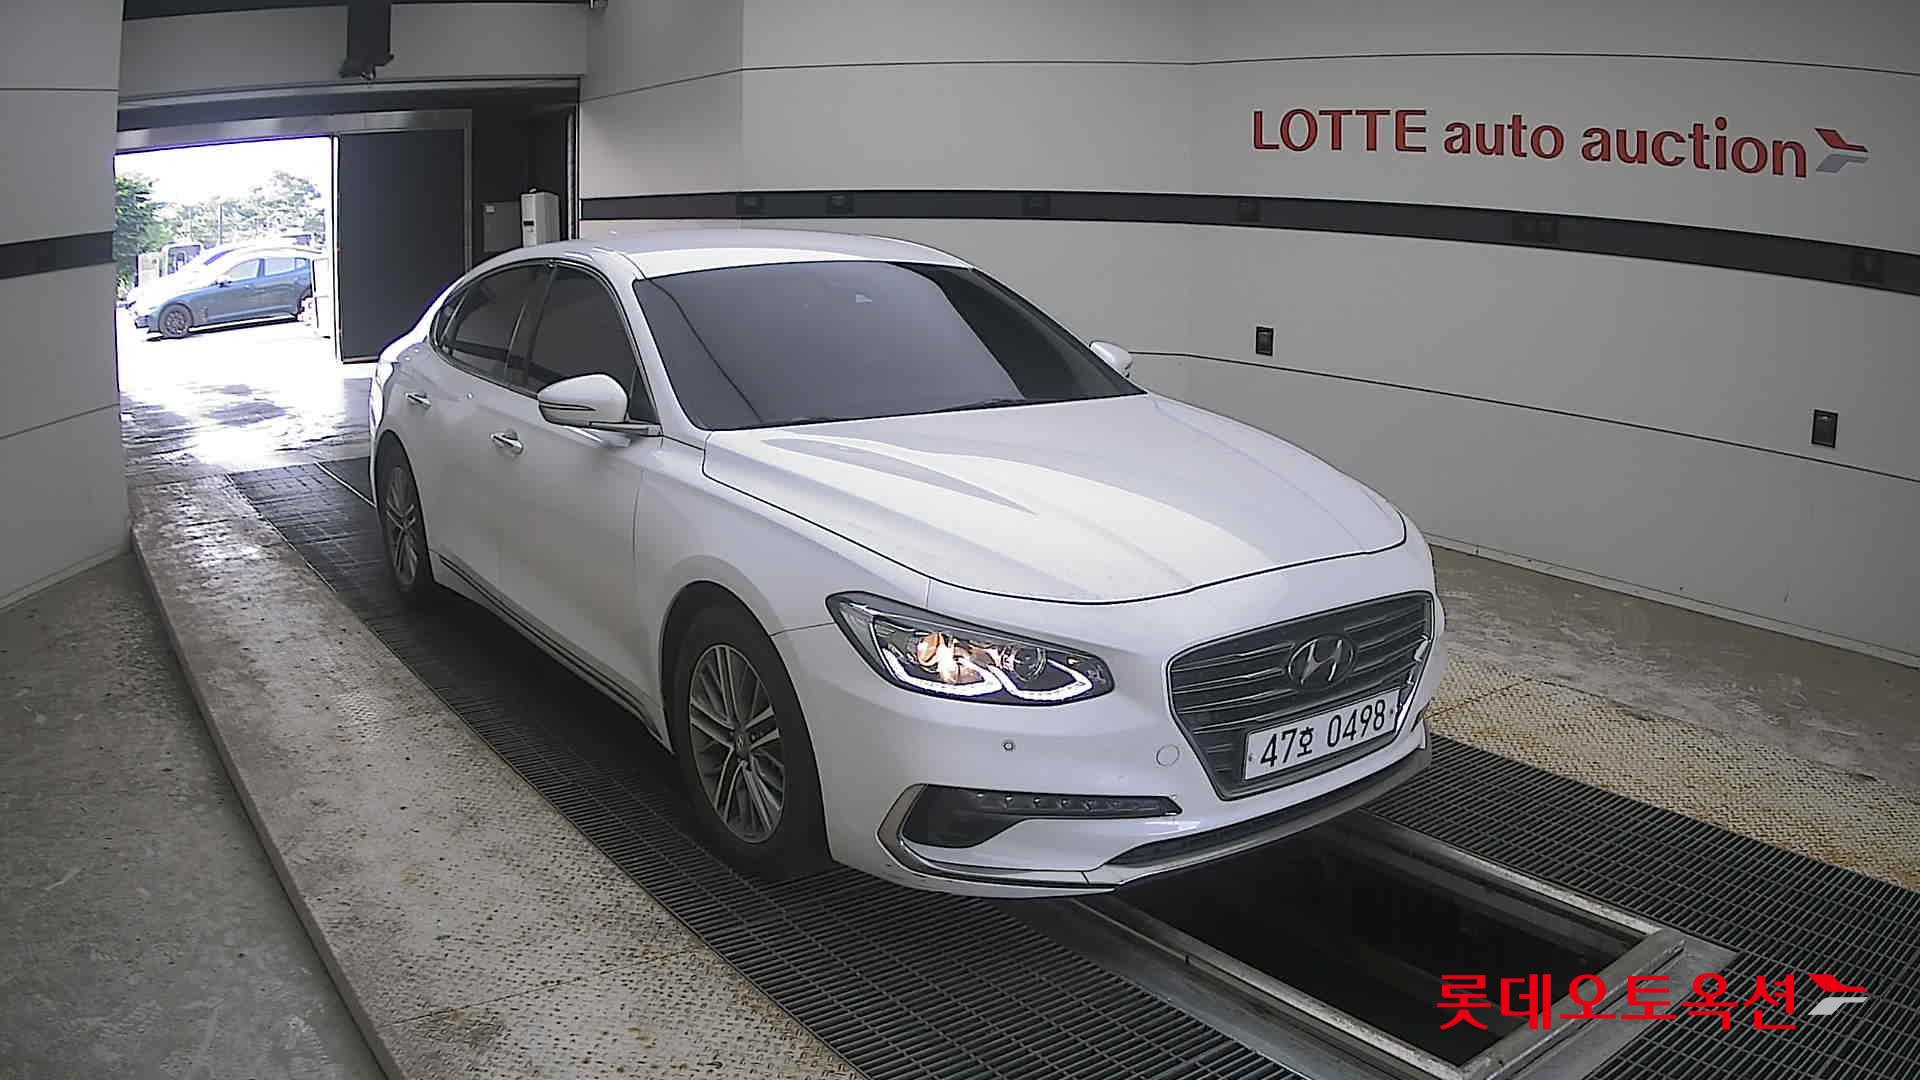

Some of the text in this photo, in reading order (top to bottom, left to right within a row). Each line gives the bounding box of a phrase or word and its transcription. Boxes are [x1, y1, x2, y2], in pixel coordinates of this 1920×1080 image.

[1252, 109, 1808, 178] LOTTE auto auction
[1260, 699, 1386, 767] 47호 0498
